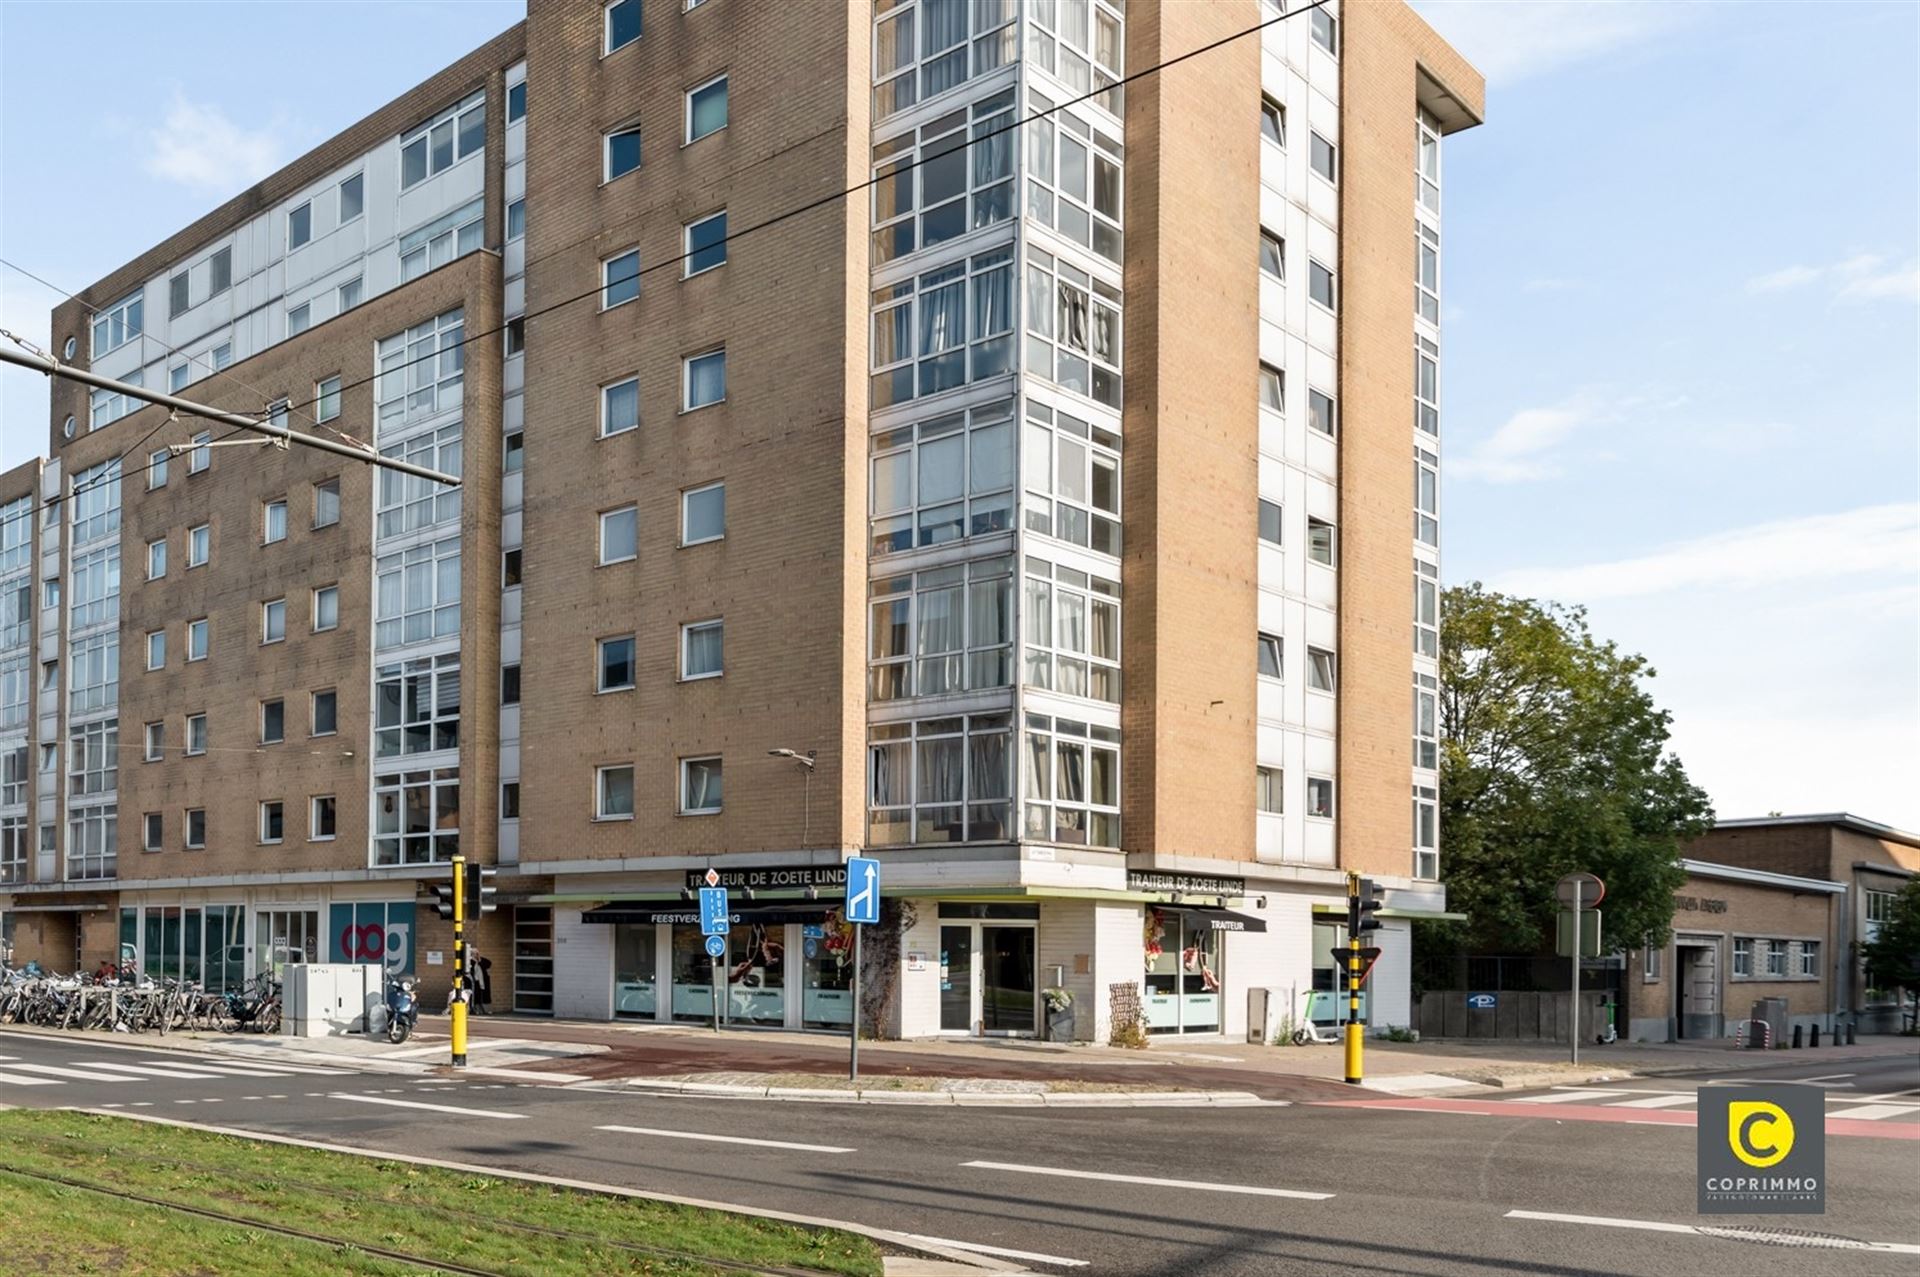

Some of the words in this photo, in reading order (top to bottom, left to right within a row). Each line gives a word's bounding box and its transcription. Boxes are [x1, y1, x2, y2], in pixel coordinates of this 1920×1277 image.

[689, 873, 745, 886] TRTEUR
[750, 872, 766, 885] DE
[771, 871, 811, 884] ZOETE
[815, 870, 846, 883] LIND
[1130, 873, 1174, 889] TRAITEUR
[1177, 876, 1189, 890] DE
[1191, 877, 1217, 892] ZOETE
[1219, 880, 1243, 894] LINDE
[1211, 920, 1244, 931] TRAITEUR
